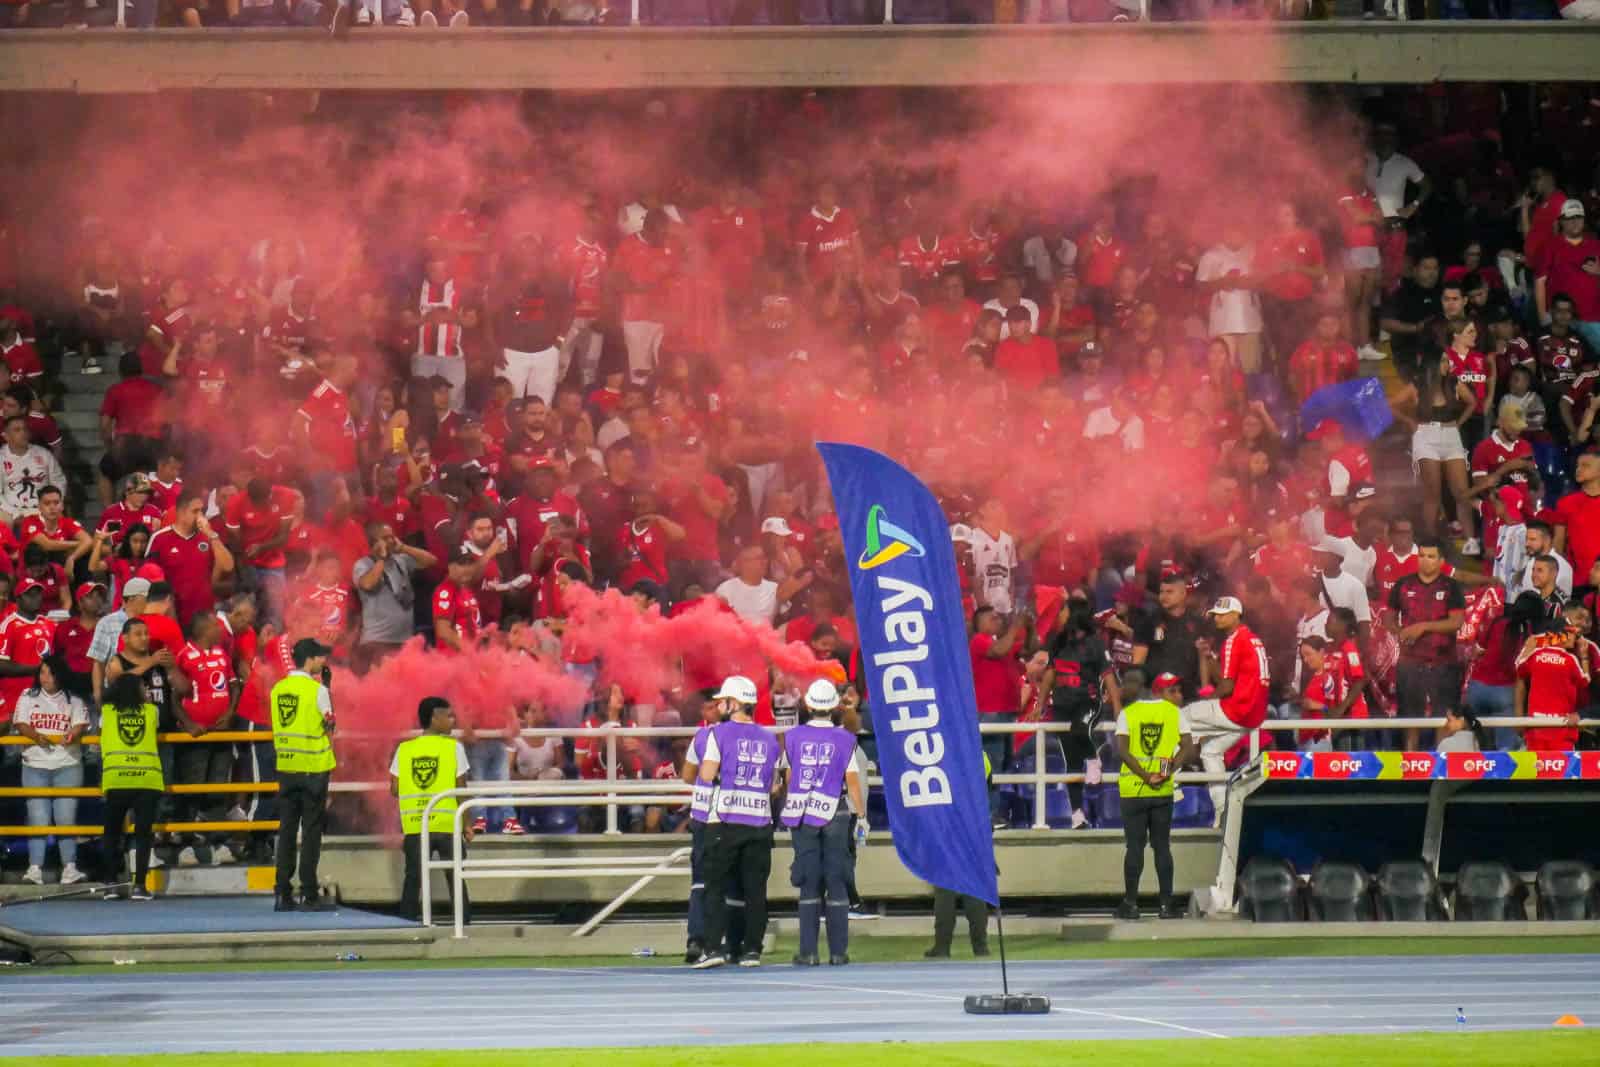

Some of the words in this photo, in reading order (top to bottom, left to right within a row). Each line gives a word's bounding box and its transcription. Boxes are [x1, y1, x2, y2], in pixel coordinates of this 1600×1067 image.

[874, 576, 952, 808] BetPlay
[119, 718, 144, 726] APOLO
[414, 760, 437, 769] APOLO
[1277, 760, 1297, 772] FCF
[1342, 760, 1362, 772] FCF
[1411, 760, 1431, 772] FCF
[1476, 760, 1496, 772] FCF
[1545, 760, 1565, 772] FCF
